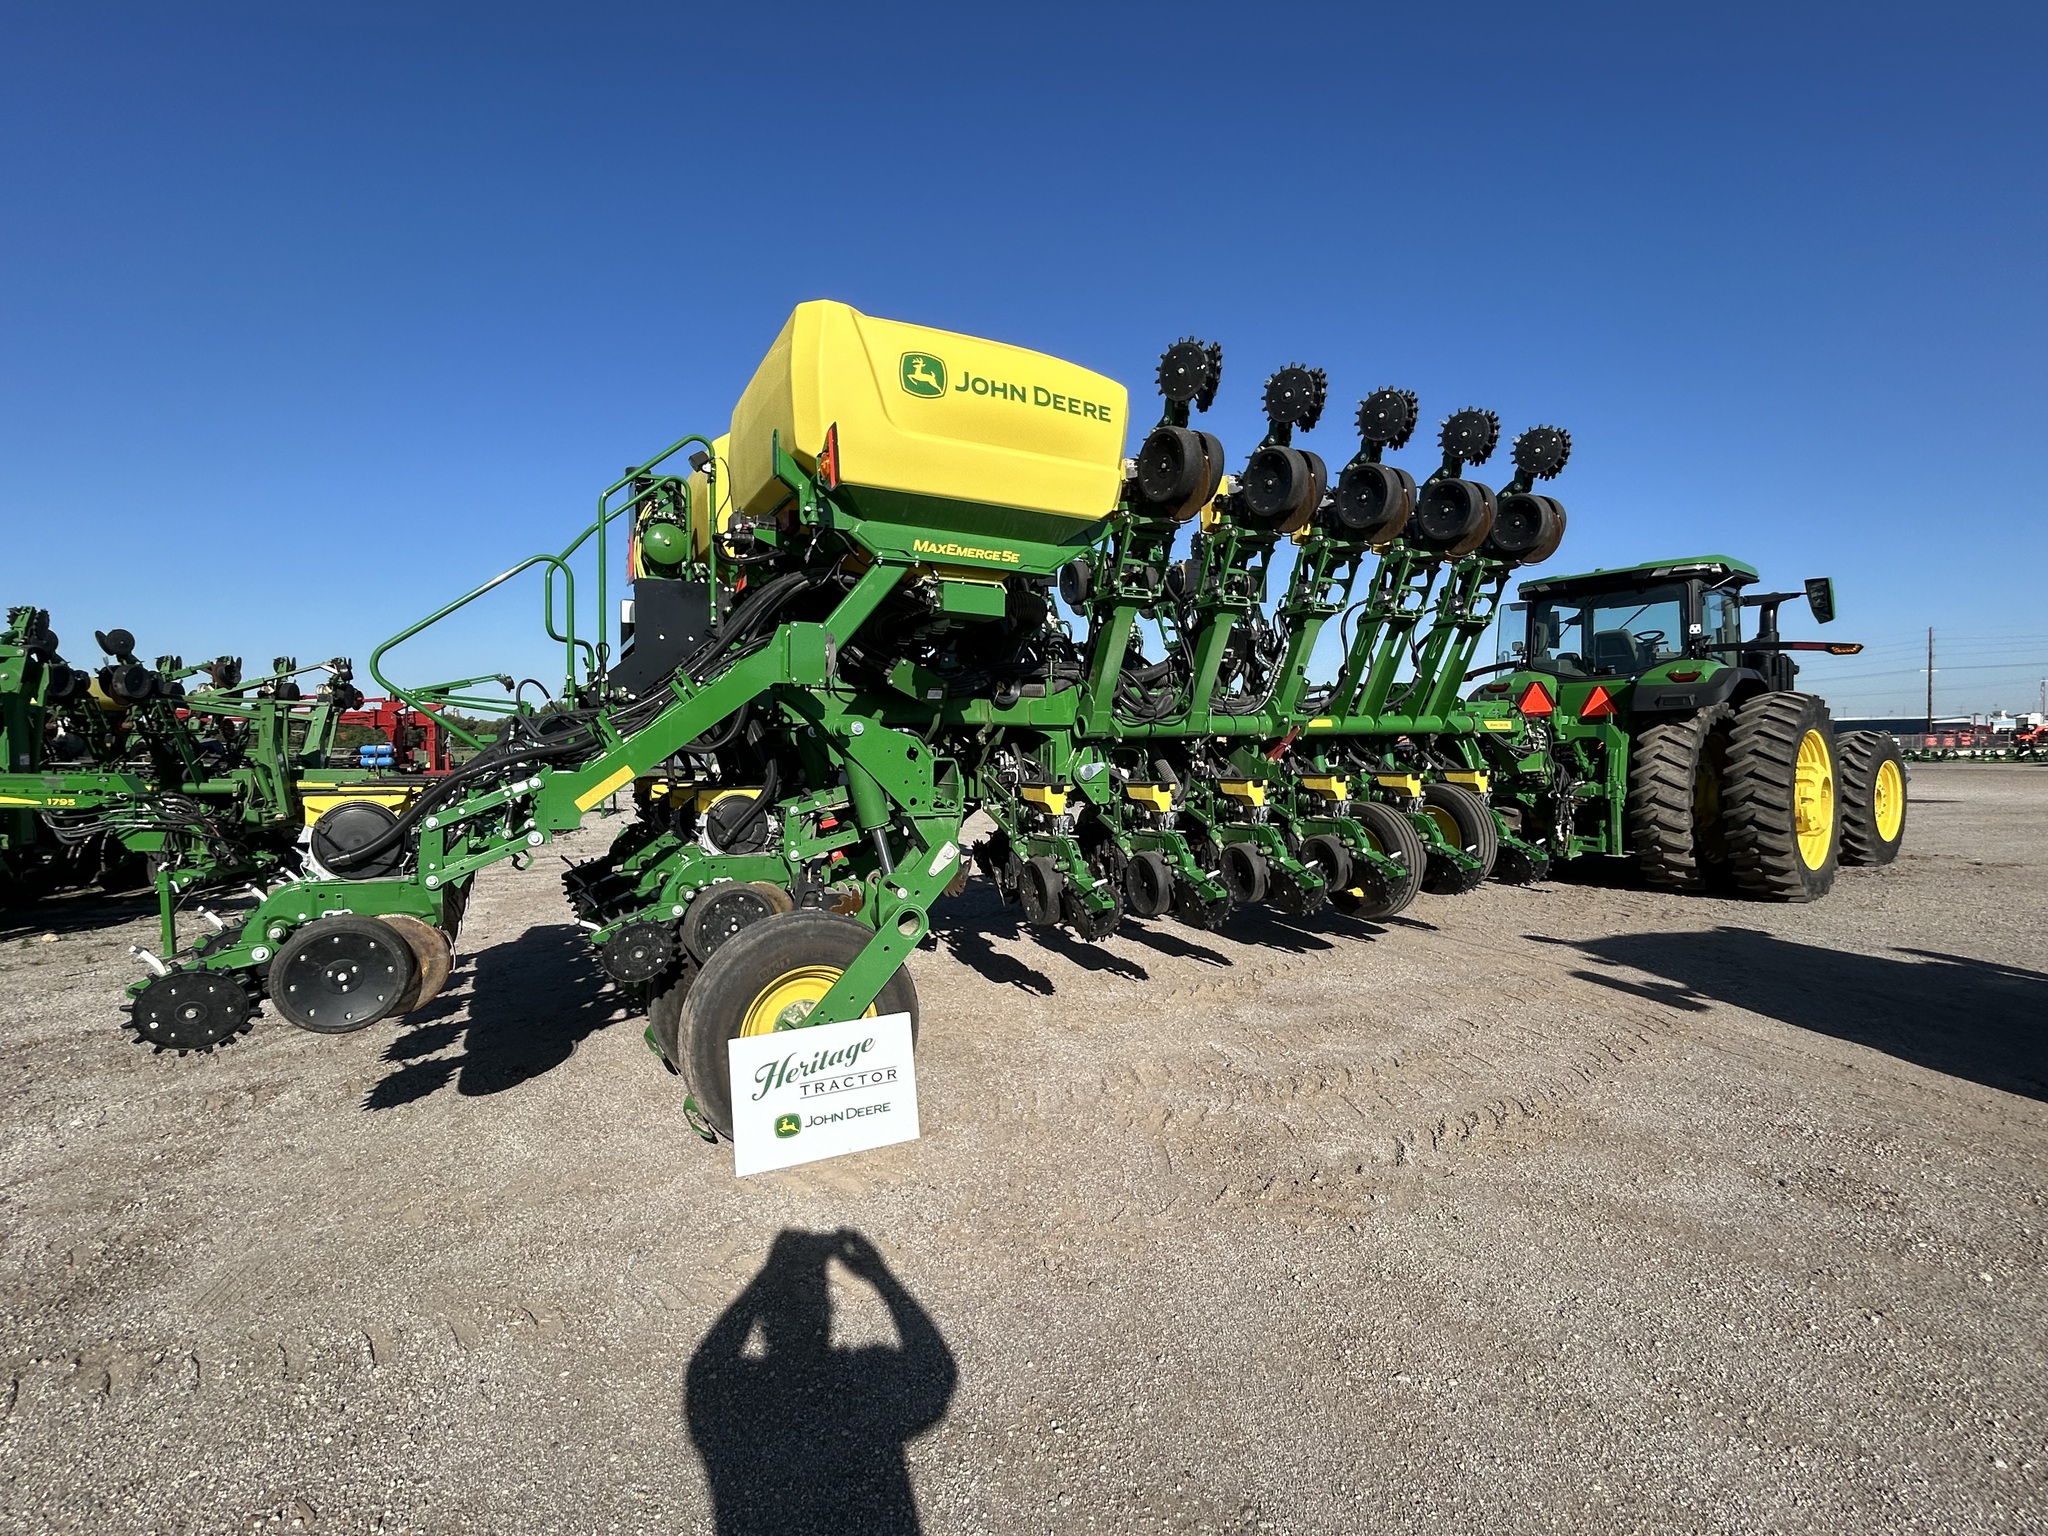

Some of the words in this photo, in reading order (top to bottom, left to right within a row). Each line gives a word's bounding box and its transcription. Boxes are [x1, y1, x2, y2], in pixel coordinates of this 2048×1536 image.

[955, 371, 1026, 403] JOHN
[1033, 385, 1111, 423] DEERE
[46, 797, 76, 806] 1795
[751, 1037, 876, 1101] Heritage
[800, 1069, 897, 1096] TRACTOR
[805, 1111, 844, 1128] JOHN
[846, 1102, 891, 1120] DEERE
